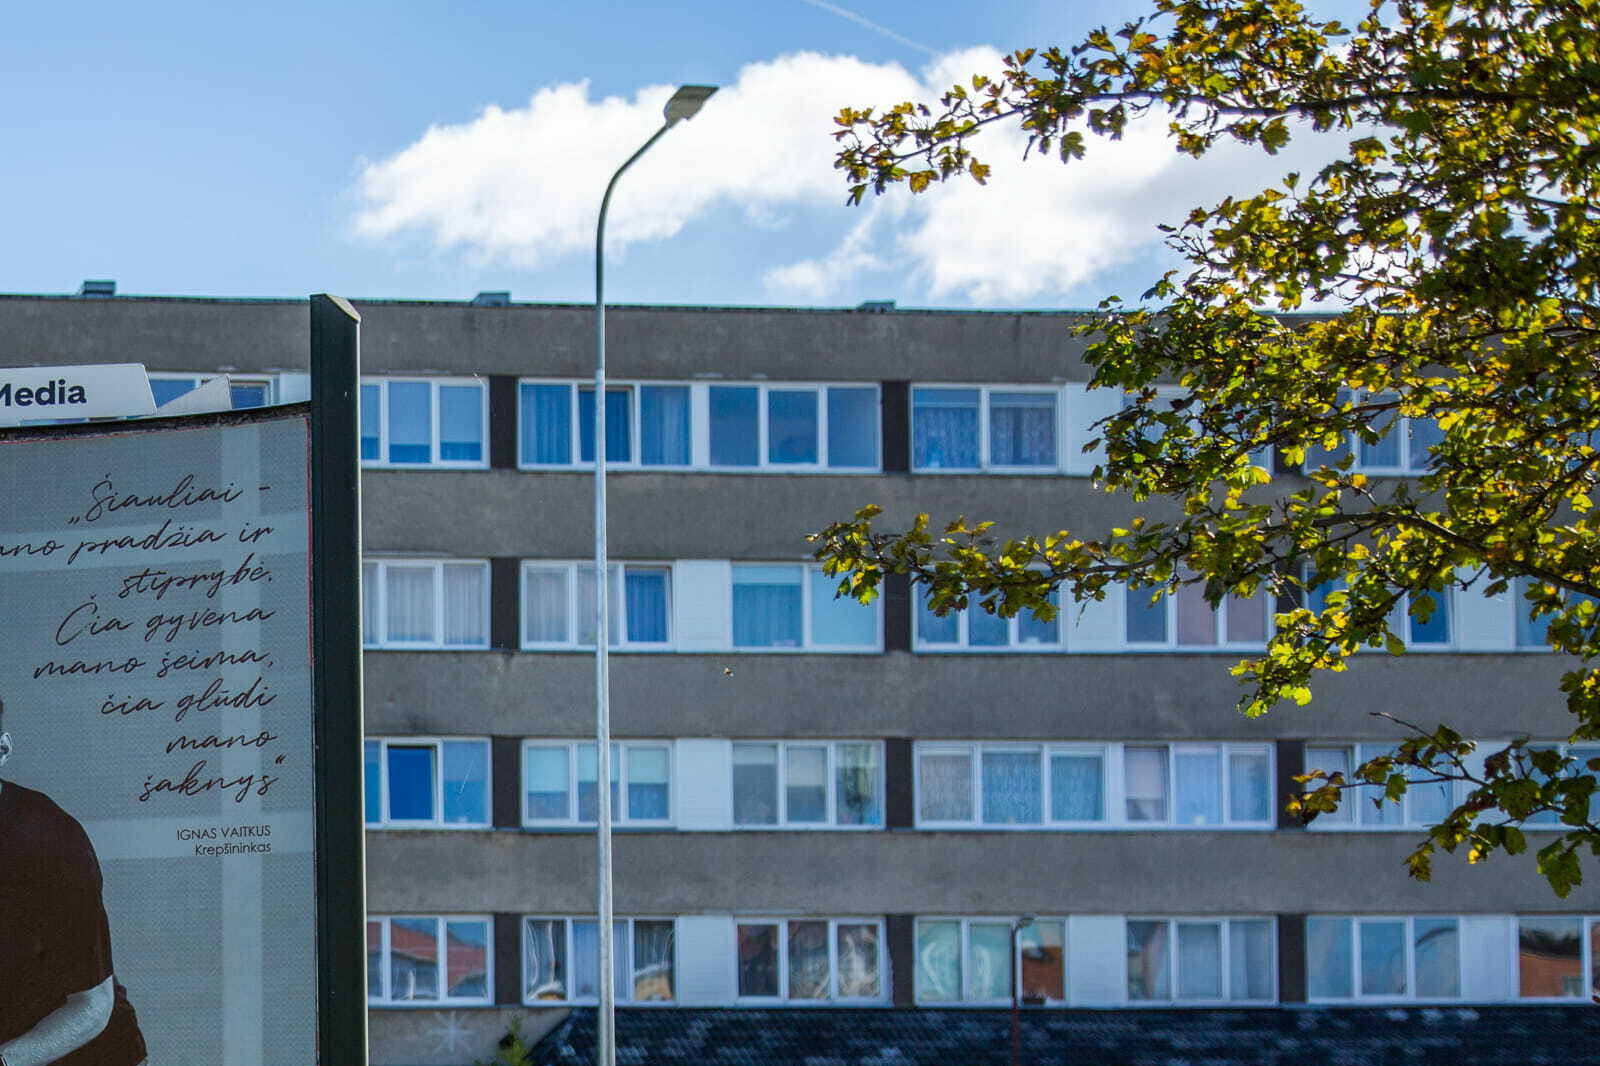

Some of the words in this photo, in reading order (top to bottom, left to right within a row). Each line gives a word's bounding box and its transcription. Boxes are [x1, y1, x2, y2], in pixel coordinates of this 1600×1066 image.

[67, 519, 229, 566] pradžia
[238, 522, 275, 544] ir
[56, 595, 135, 646] Čia
[145, 606, 276, 642] gyvena
[33, 656, 146, 680] mano
[156, 649, 274, 678] šeima,
[101, 693, 165, 715] čia
[175, 677, 278, 722] glūdi
[166, 730, 278, 754] mano
[176, 827, 217, 841] IGNAS
[220, 824, 272, 838] VAITKUS
[195, 843, 272, 857] Krepšininkas
